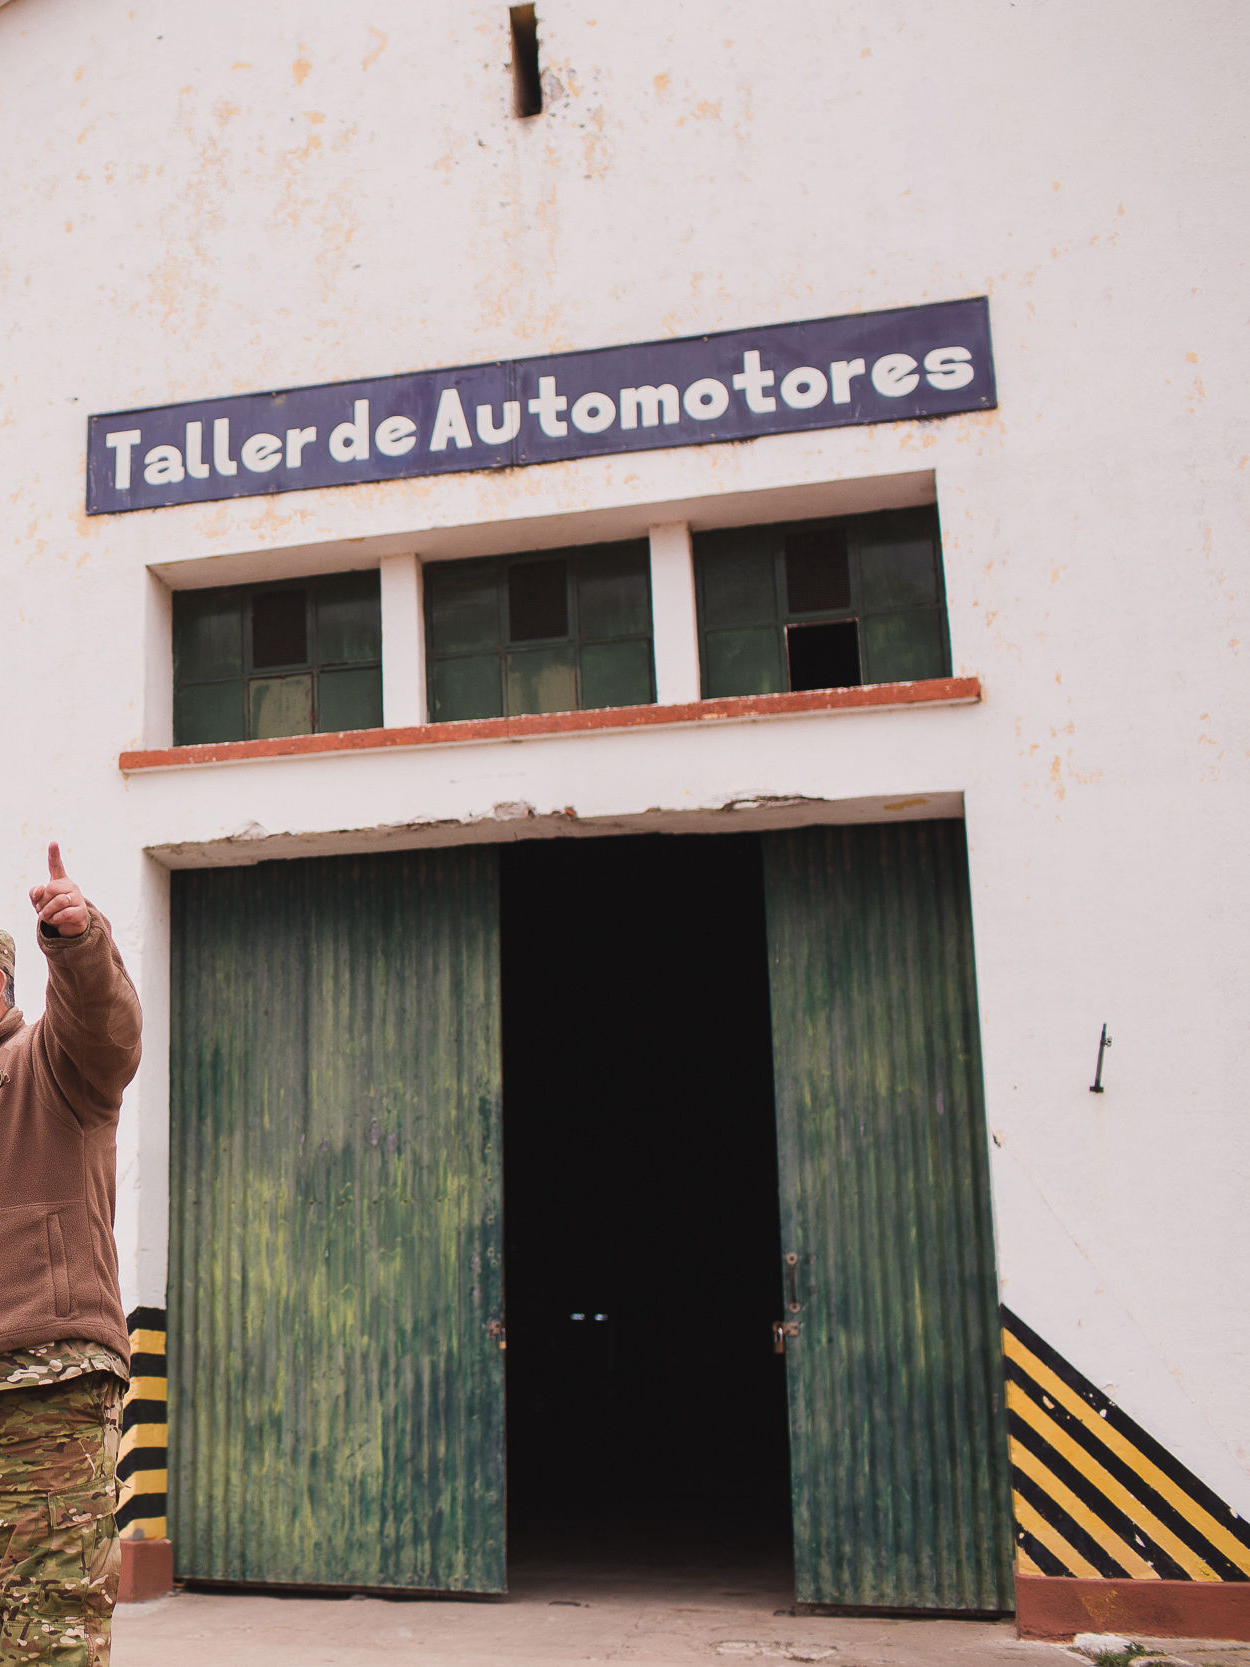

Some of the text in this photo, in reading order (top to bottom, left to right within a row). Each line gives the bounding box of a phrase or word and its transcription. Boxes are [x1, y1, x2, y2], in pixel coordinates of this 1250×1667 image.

[105, 346, 976, 490] Taller de Automotores
